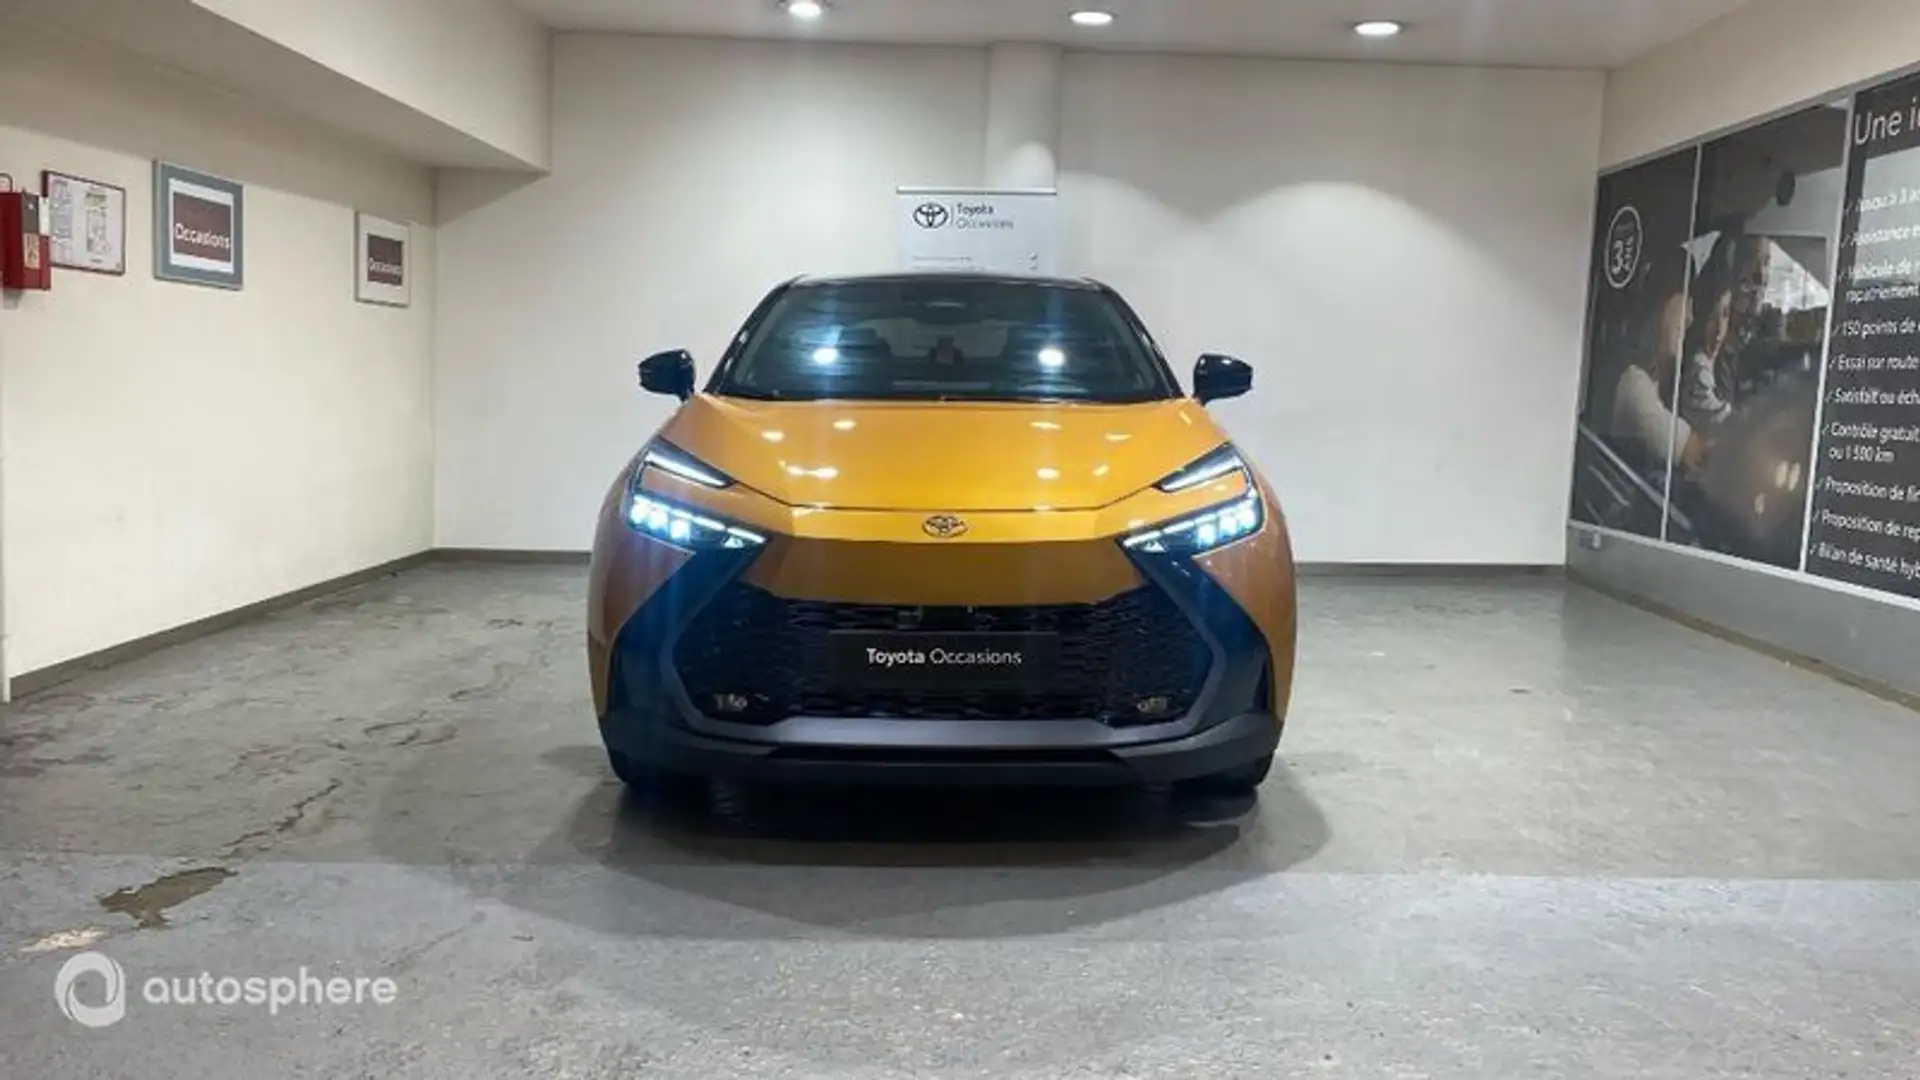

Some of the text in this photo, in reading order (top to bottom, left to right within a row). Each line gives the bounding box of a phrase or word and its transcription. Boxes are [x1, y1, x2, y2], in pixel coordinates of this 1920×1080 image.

[1855, 95, 1920, 145] Une i
[956, 202, 994, 216] Toyota
[175, 222, 231, 249] Occasions
[1862, 320, 1898, 340] points
[1900, 317, 1917, 334] de
[1838, 354, 1866, 372] Essai
[1867, 357, 1885, 371] sur
[1835, 387, 1879, 405] Satisfait
[1880, 392, 1895, 405] ou
[1828, 446, 1844, 460] ou
[1826, 475, 1887, 498] Proposition
[1888, 484, 1904, 501] de
[1822, 508, 1882, 534] Proposition
[1884, 520, 1901, 537] de
[1818, 541, 1847, 562] Bilan
[1848, 547, 1863, 566] de
[1865, 553, 1898, 575] santé
[866, 647, 1022, 668] Toyota Occasions
